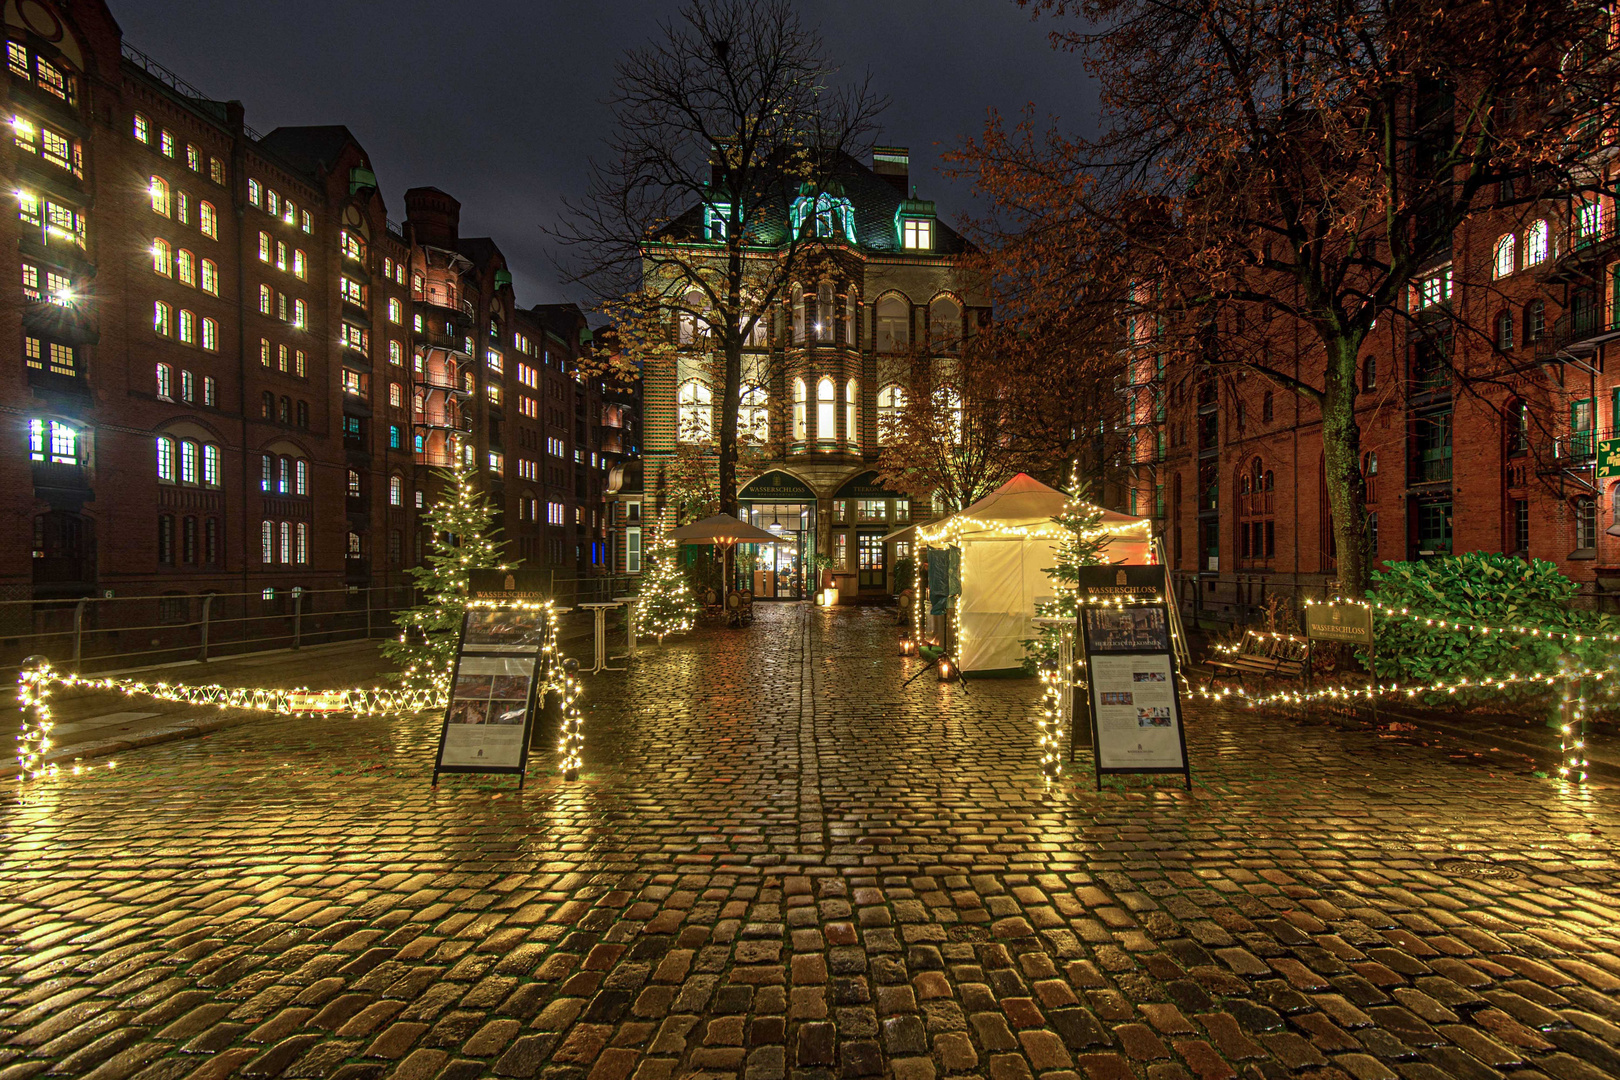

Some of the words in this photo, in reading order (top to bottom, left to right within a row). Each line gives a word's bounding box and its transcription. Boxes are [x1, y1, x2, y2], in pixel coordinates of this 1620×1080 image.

[105, 590, 113, 599] 6
[1088, 586, 1157, 594] WASSERSCHLOSS
[1311, 623, 1366, 635] WASSERSCHLOSS
